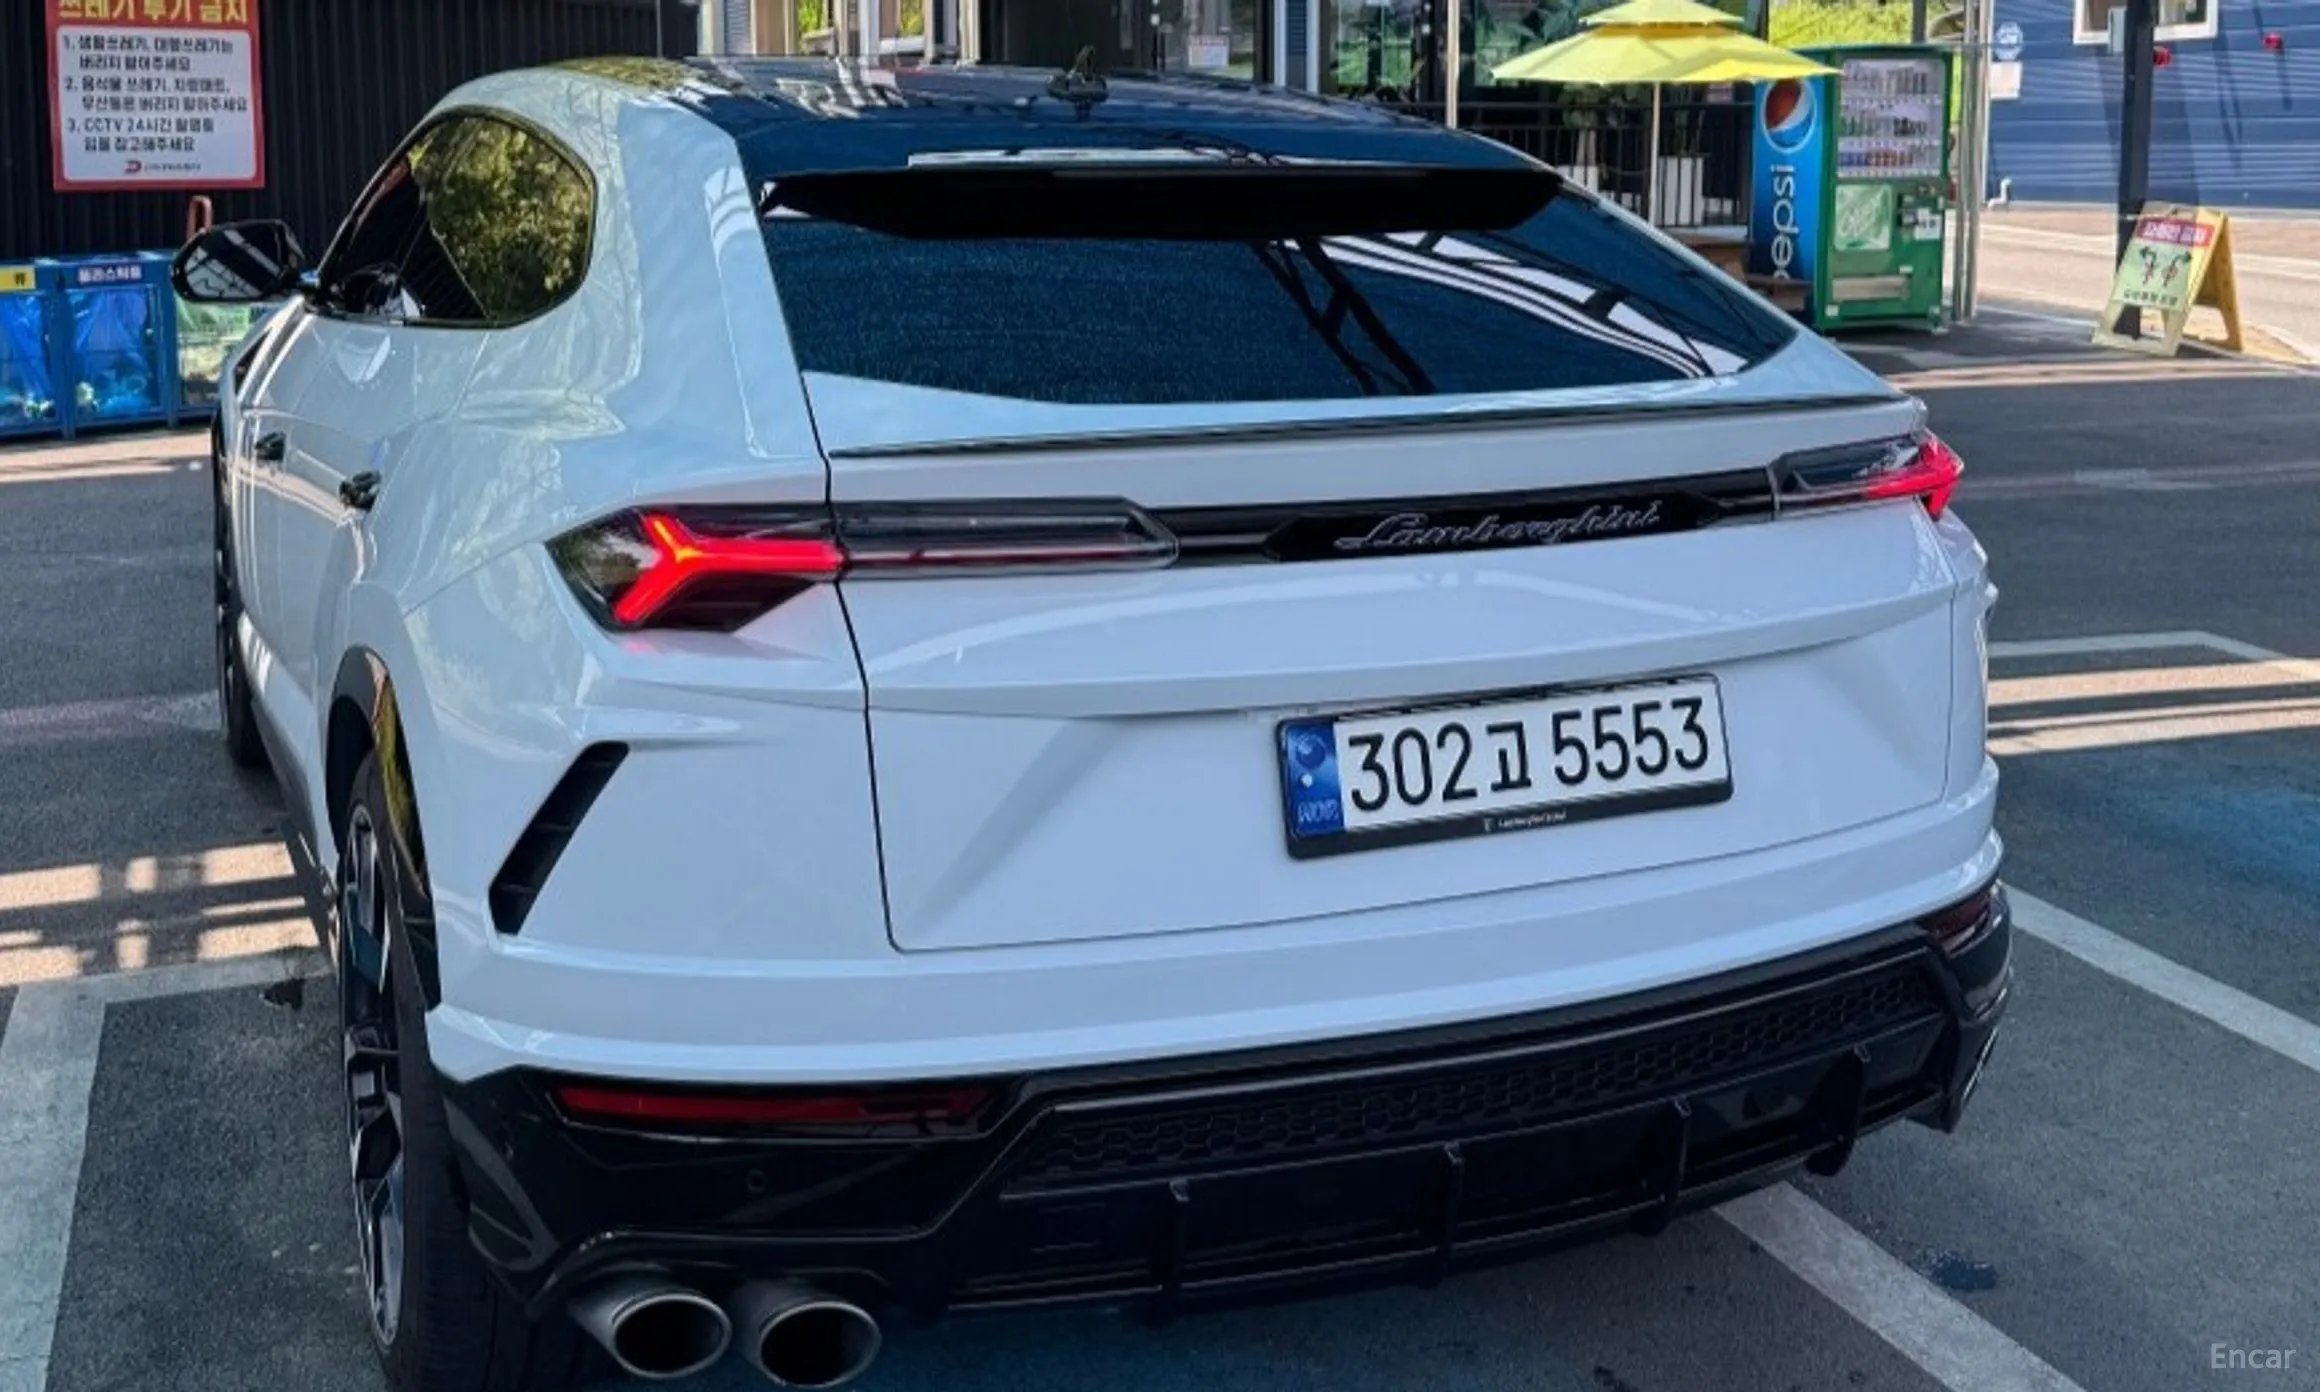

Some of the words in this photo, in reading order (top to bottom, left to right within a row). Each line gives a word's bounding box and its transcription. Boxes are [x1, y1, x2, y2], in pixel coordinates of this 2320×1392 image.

[84, 117, 122, 133] CCTV
[1335, 500, 1662, 549] Lamborghini
[1551, 697, 1710, 786] 5553
